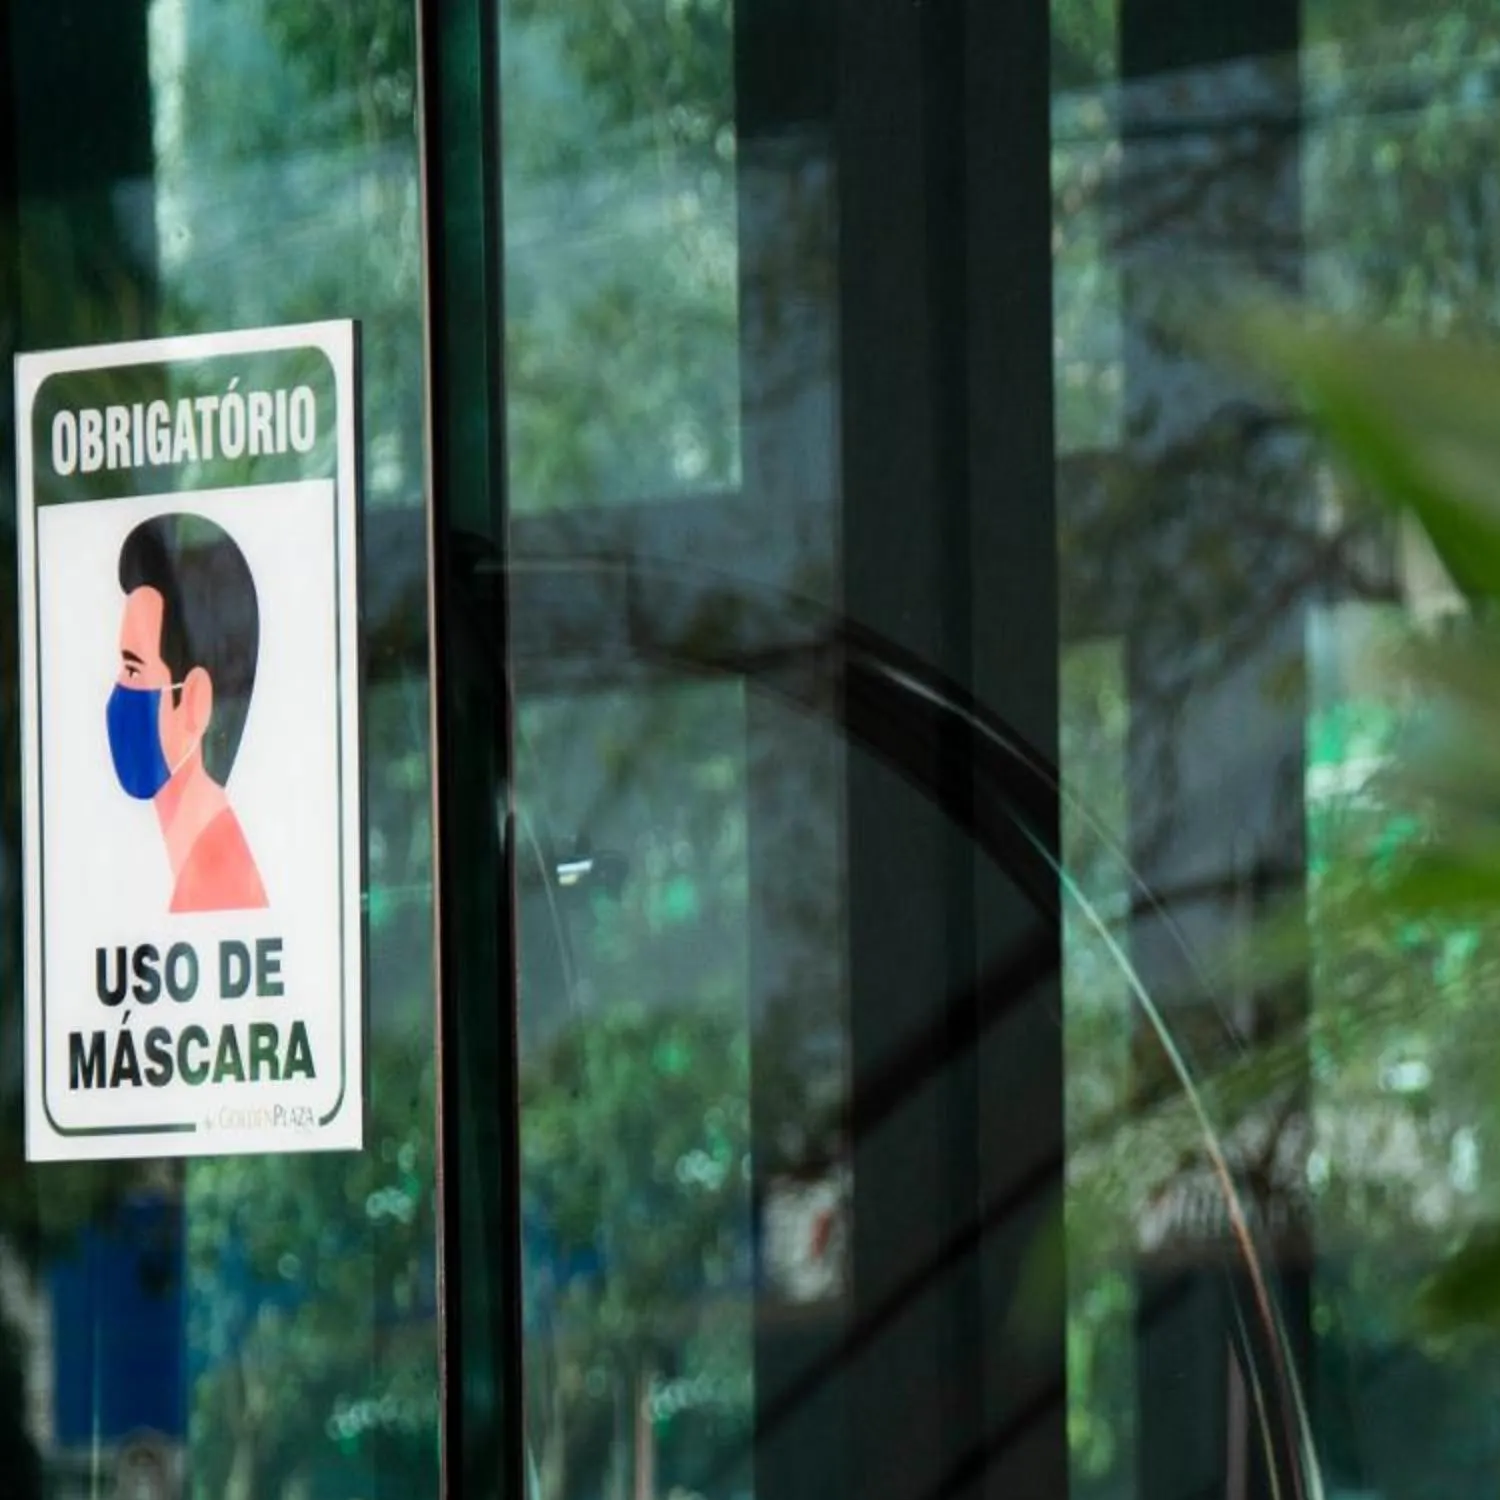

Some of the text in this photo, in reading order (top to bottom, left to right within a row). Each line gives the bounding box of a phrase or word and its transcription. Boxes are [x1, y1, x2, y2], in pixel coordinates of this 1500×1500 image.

[51, 377, 317, 477] OBRIGATÓRIO
[95, 937, 285, 1007] USO DE
[68, 1010, 317, 1090] MÁSCARA
